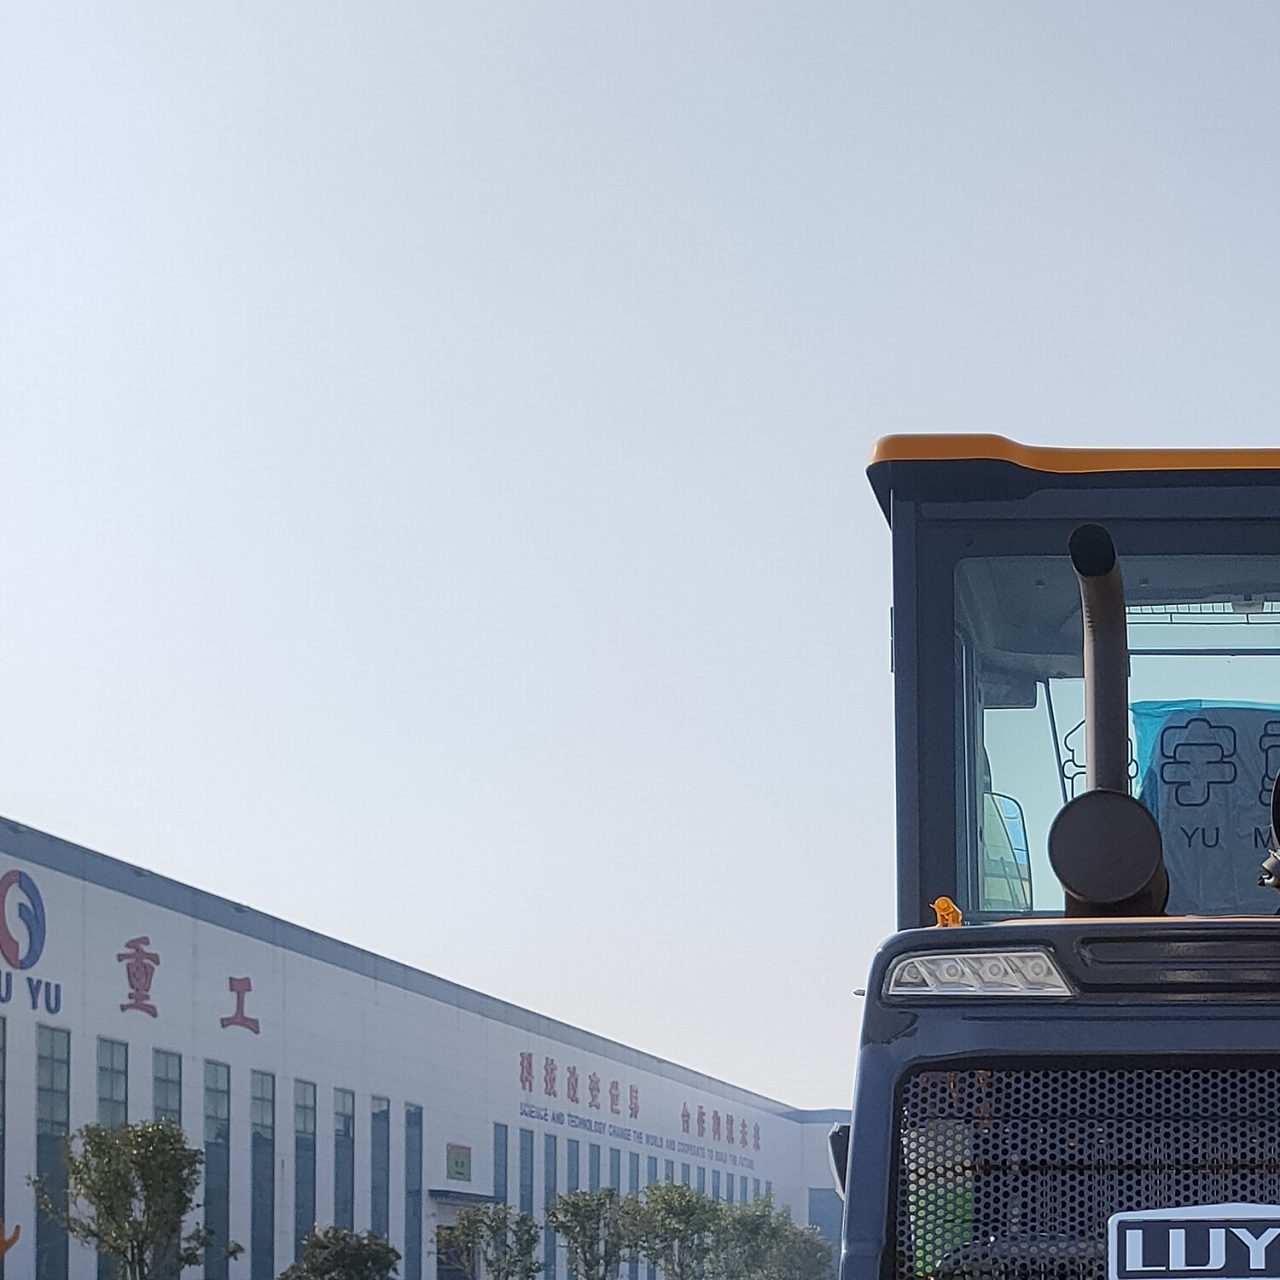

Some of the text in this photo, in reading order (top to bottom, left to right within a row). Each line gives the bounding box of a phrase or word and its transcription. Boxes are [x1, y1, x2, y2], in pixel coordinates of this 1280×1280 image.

[1180, 827, 1219, 848] YU
[26, 976, 61, 1014] YU
[116, 935, 260, 1034] 重工
[551, 1111, 564, 1125] AND
